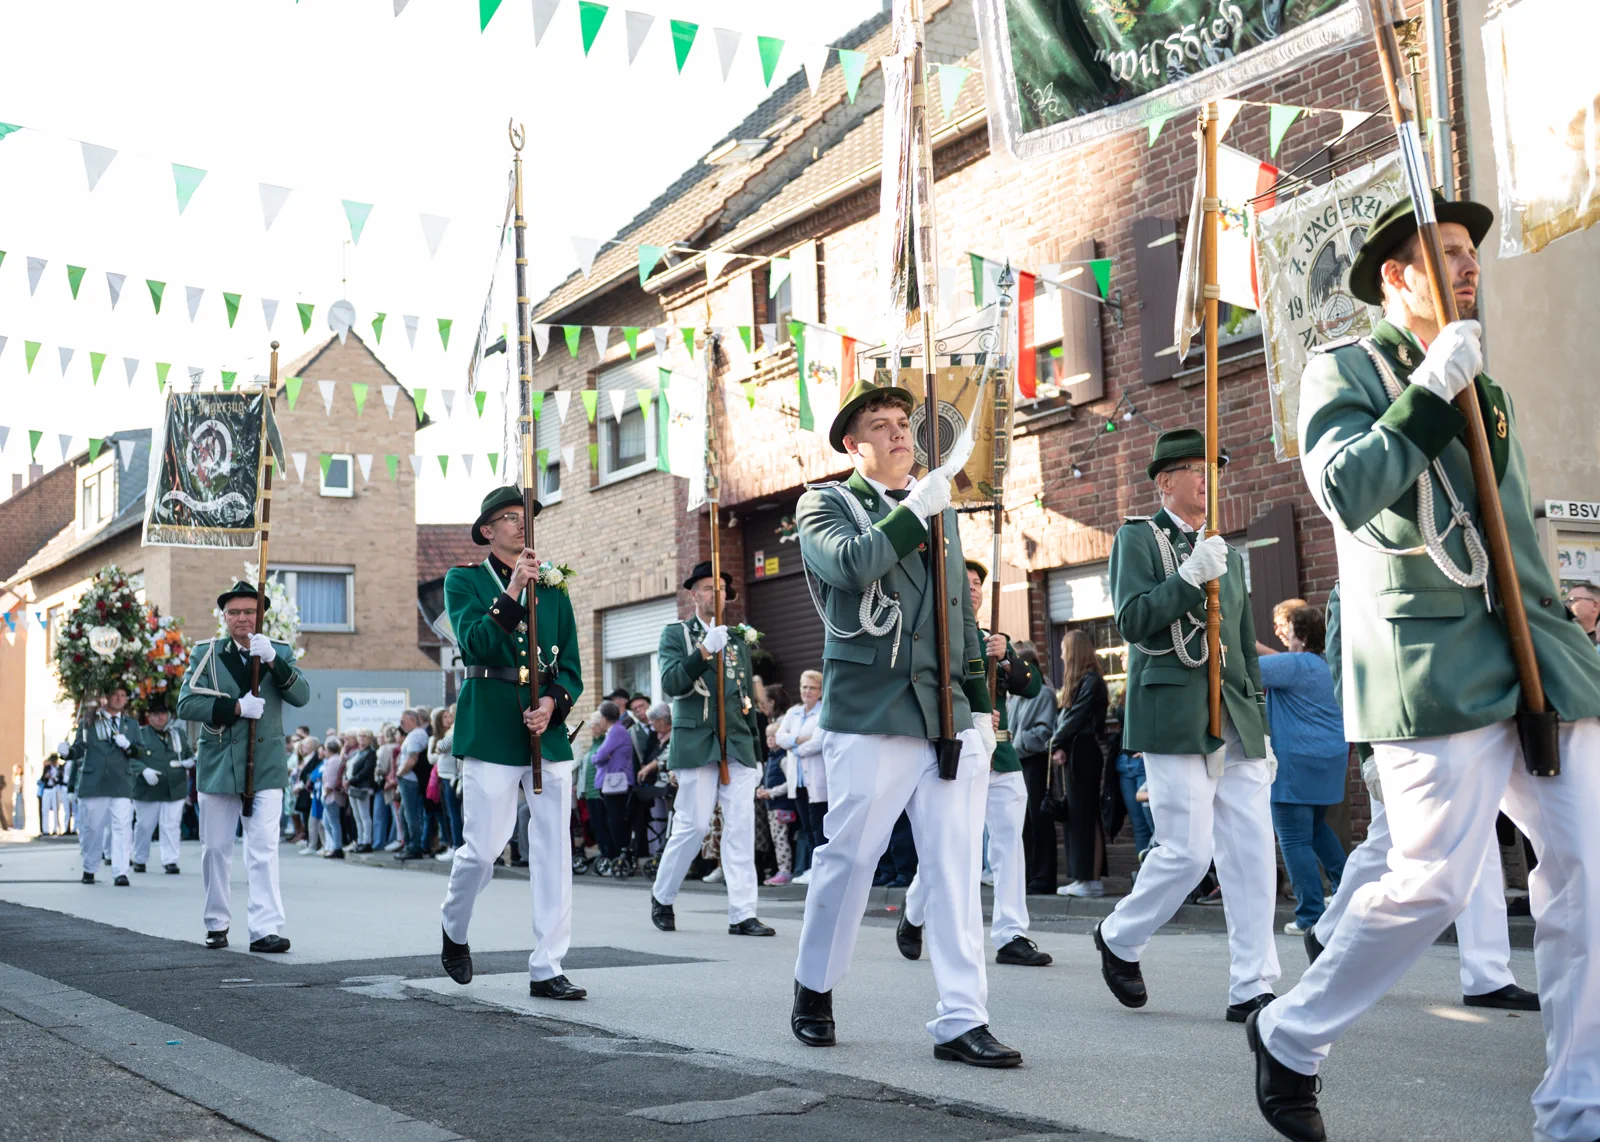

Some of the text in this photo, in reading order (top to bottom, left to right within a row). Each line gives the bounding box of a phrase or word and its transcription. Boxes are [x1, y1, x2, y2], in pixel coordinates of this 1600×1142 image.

[1298, 195, 1390, 254] JÄGERZU
[1288, 295, 1304, 321] 19
[1569, 503, 1600, 519] BSV
[380, 698, 404, 706] GmbH
